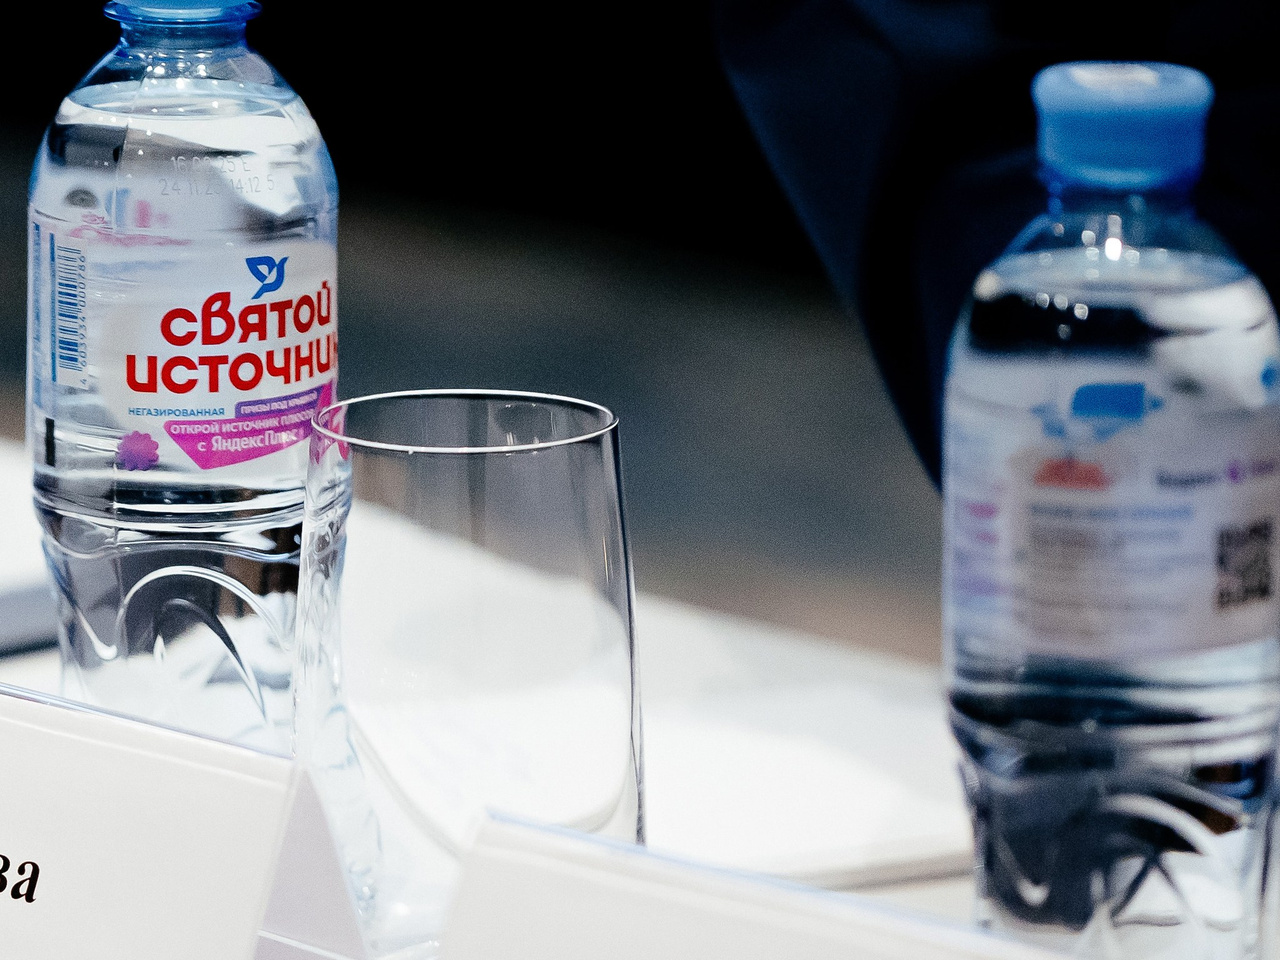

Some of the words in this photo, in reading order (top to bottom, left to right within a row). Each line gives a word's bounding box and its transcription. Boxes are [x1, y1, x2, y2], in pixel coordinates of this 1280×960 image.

[266, 174, 275, 190] 5
[78, 255, 86, 307] 000786
[79, 316, 87, 367] 603934
[128, 406, 225, 418] НЕГАЗИРОВАННАЯ
[170, 421, 220, 435] ОТКРОЙ
[221, 416, 279, 432] ИСТОЧНИК
